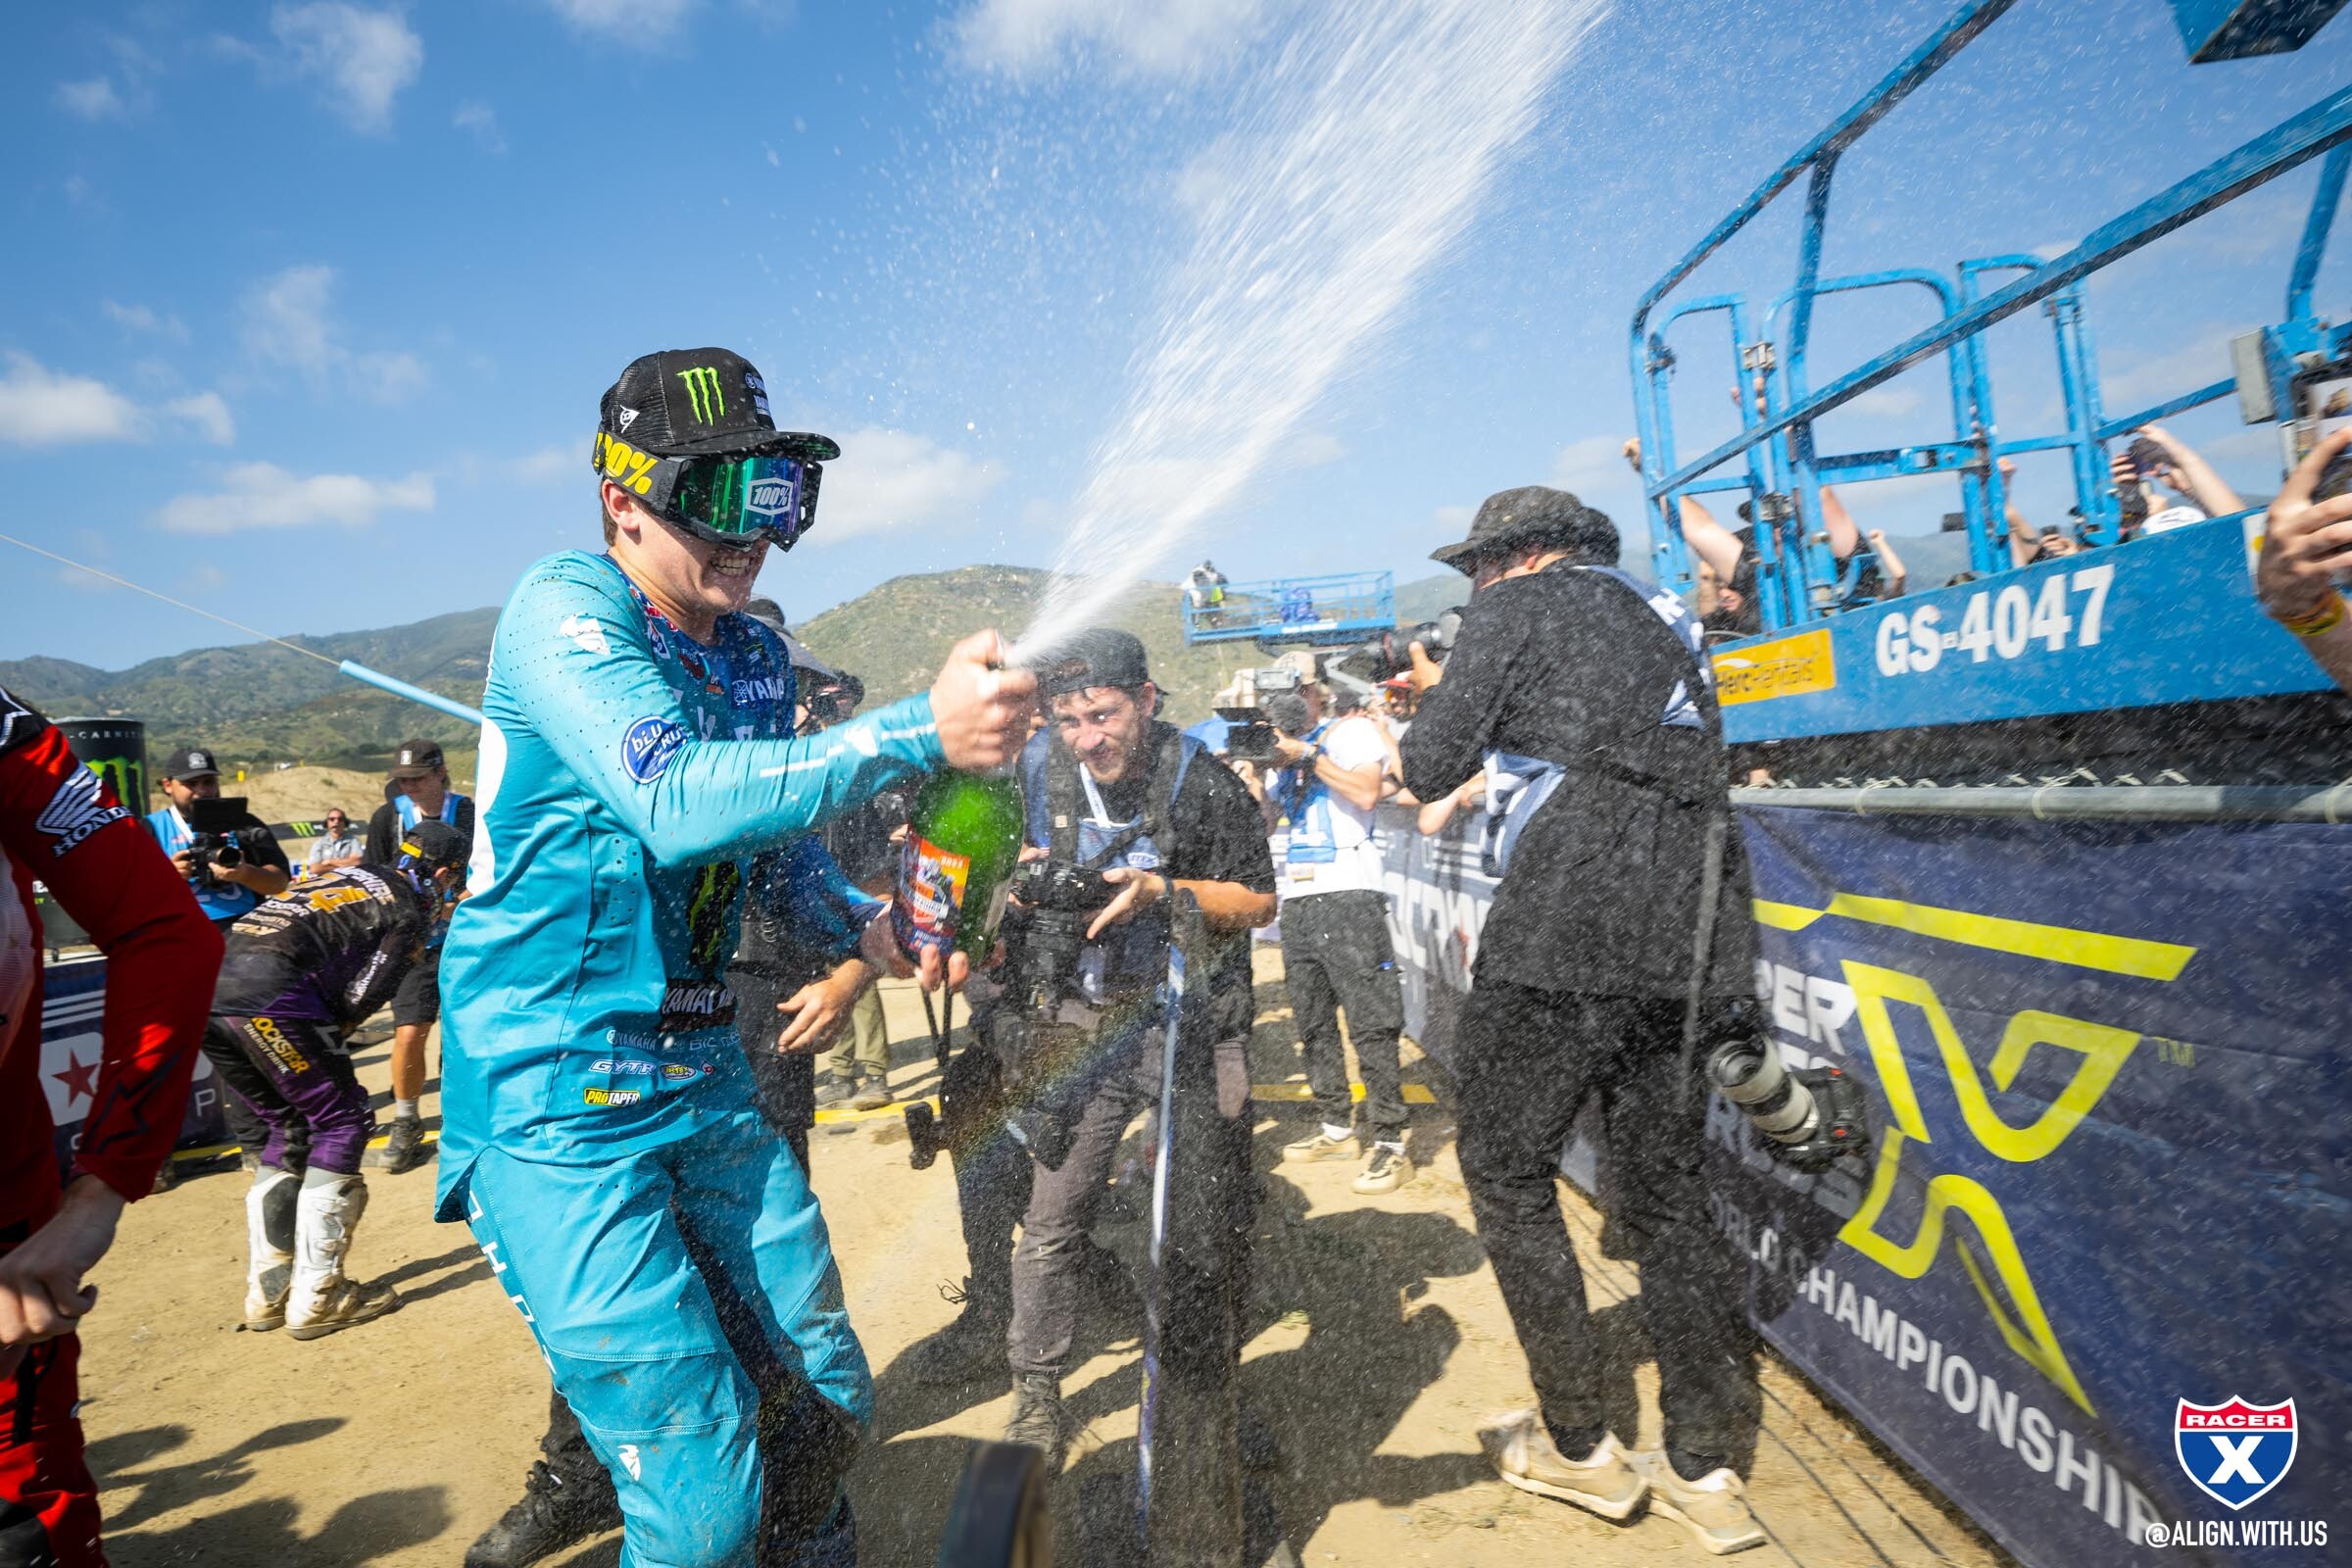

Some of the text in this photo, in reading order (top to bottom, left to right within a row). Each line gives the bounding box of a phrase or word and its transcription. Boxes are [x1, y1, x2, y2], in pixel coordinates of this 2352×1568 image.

[753, 485, 790, 507] 100%
[1876, 564, 2115, 677] GS-4047
[52, 806, 136, 858] HOND
[617, 1032, 658, 1052] YAMAHA
[589, 1059, 657, 1075] GYTR
